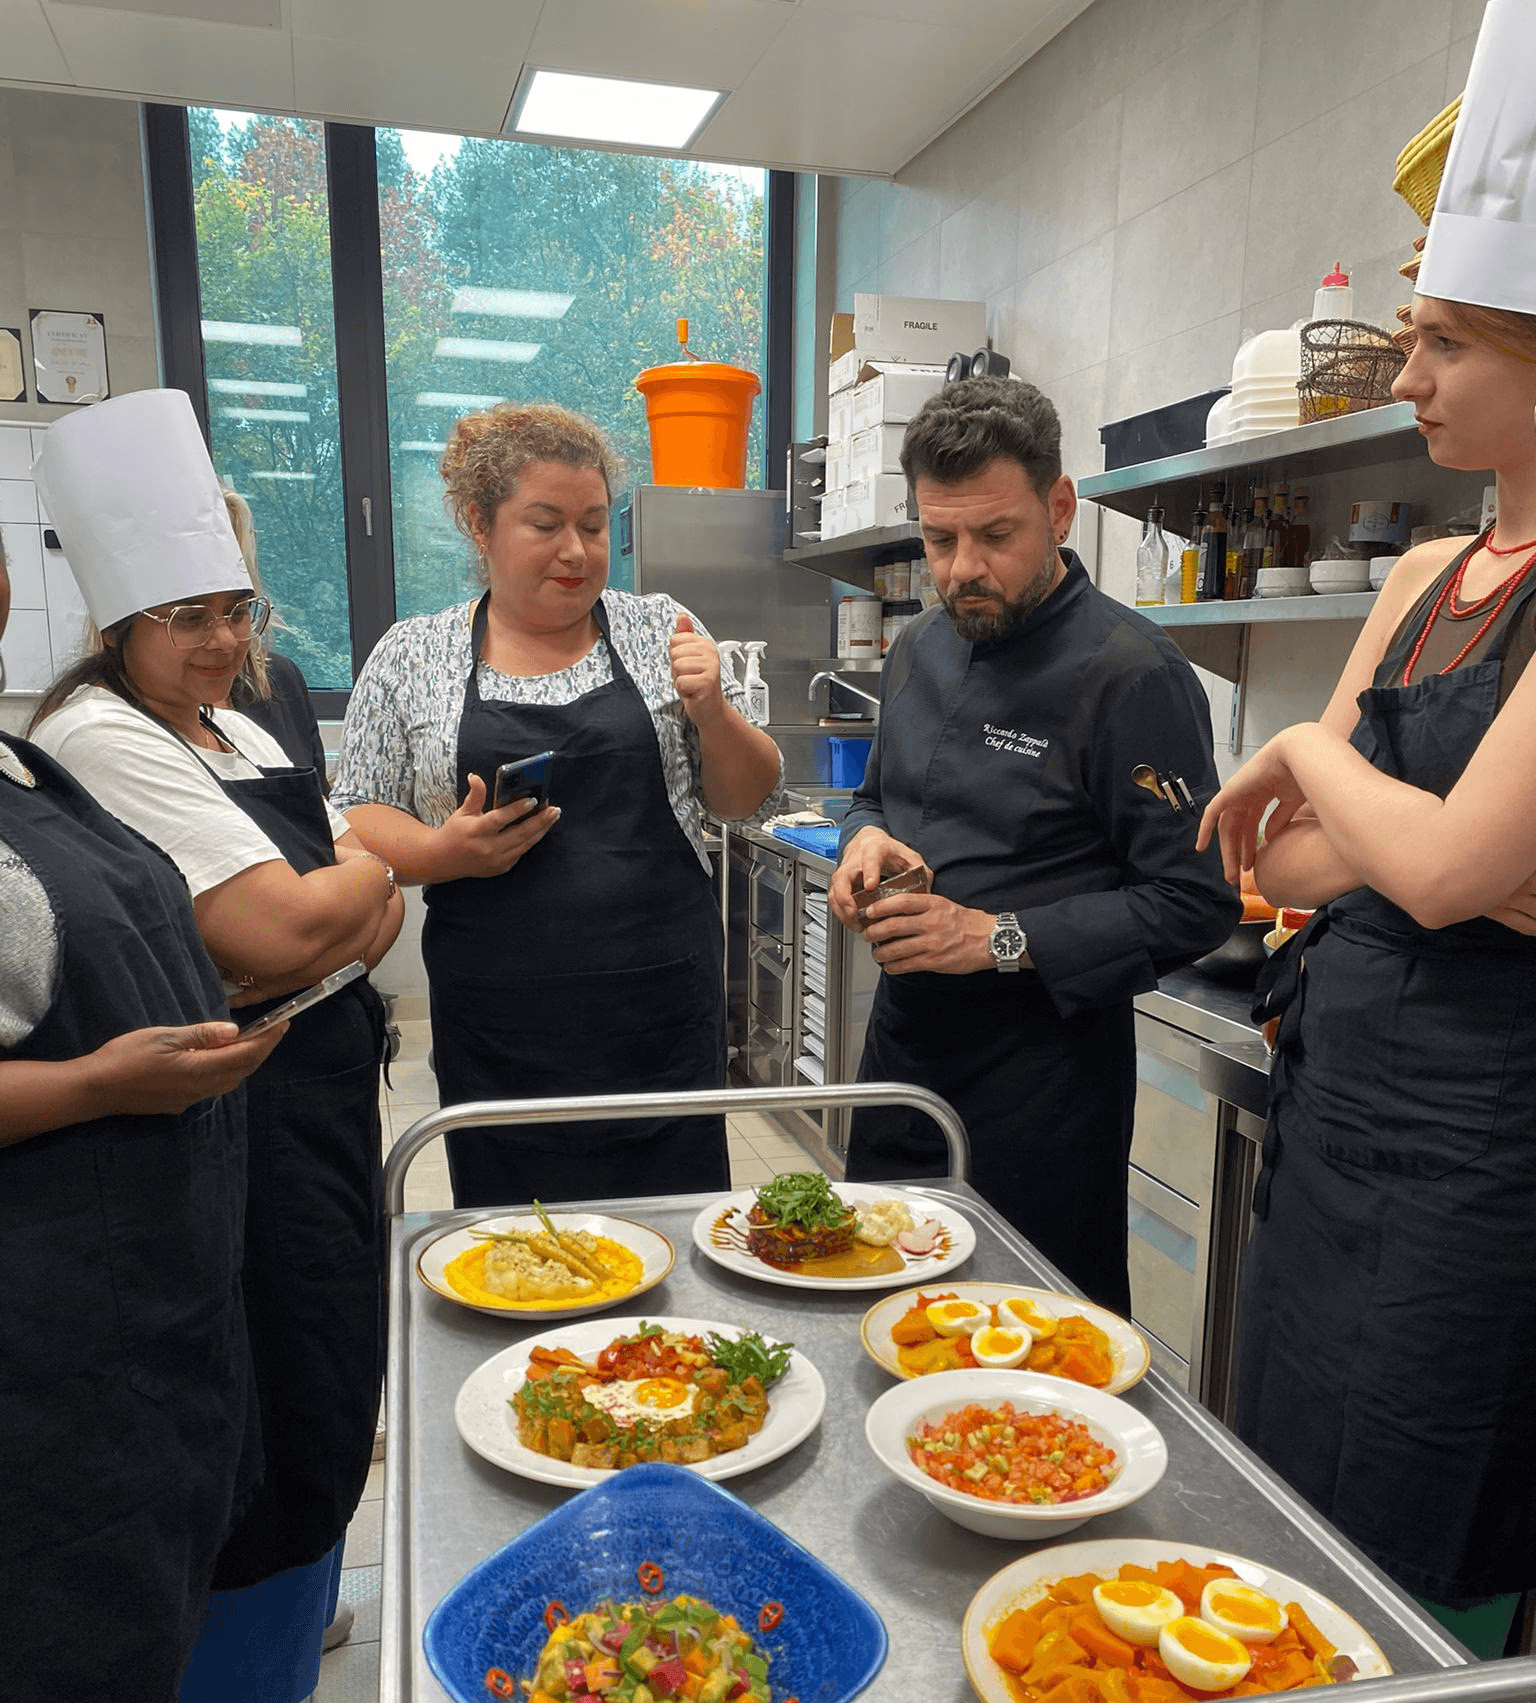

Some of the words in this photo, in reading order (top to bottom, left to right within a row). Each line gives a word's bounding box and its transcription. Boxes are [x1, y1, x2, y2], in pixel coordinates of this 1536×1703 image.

[904, 320, 938, 331] FRAGILE
[983, 723, 1017, 739] Riccardo
[985, 736, 1005, 751] Chef
[1004, 741, 1014, 751] de
[1013, 746, 1041, 758] cuisine
